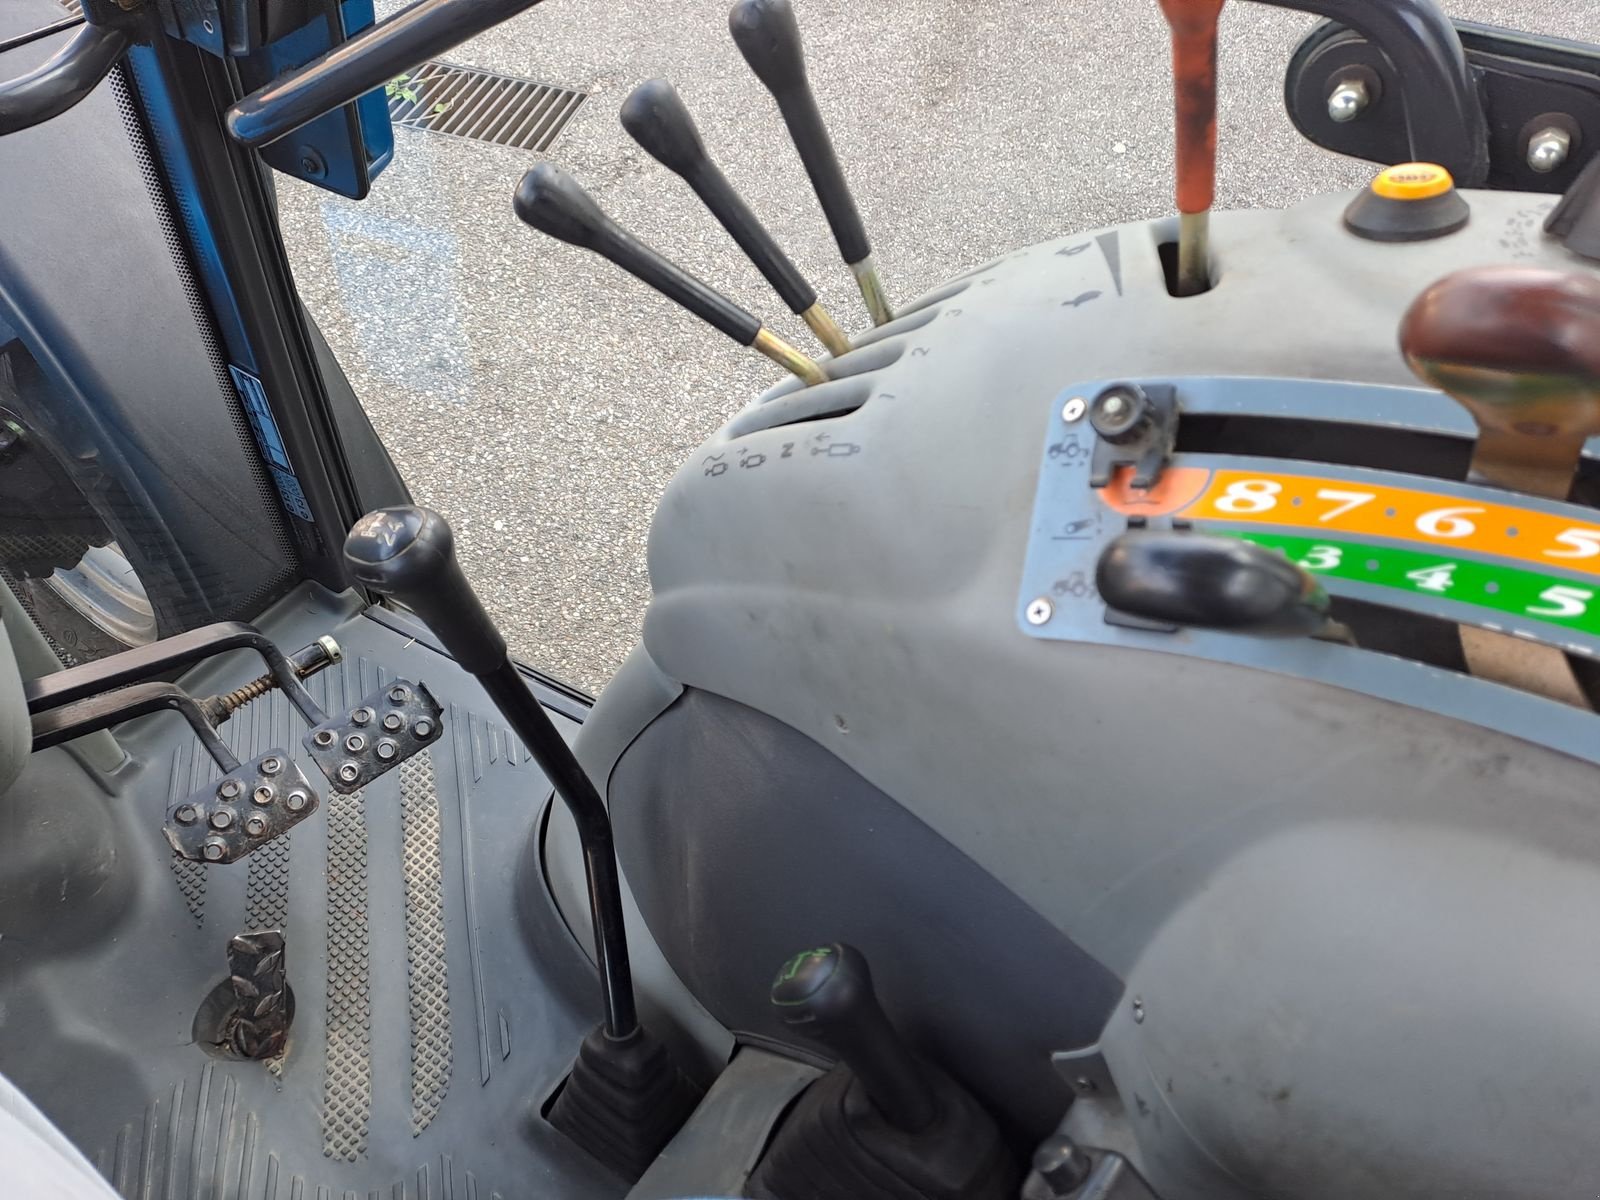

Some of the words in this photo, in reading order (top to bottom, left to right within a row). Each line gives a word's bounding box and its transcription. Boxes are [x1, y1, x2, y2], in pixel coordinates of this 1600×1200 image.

[1213, 479, 1283, 513] 8
[1316, 488, 1377, 522] 7
[1415, 506, 1487, 538] 6
[1541, 528, 1600, 558] 5
[1297, 544, 1344, 570] 3
[1406, 562, 1458, 592] 4
[1525, 584, 1594, 617] 5
